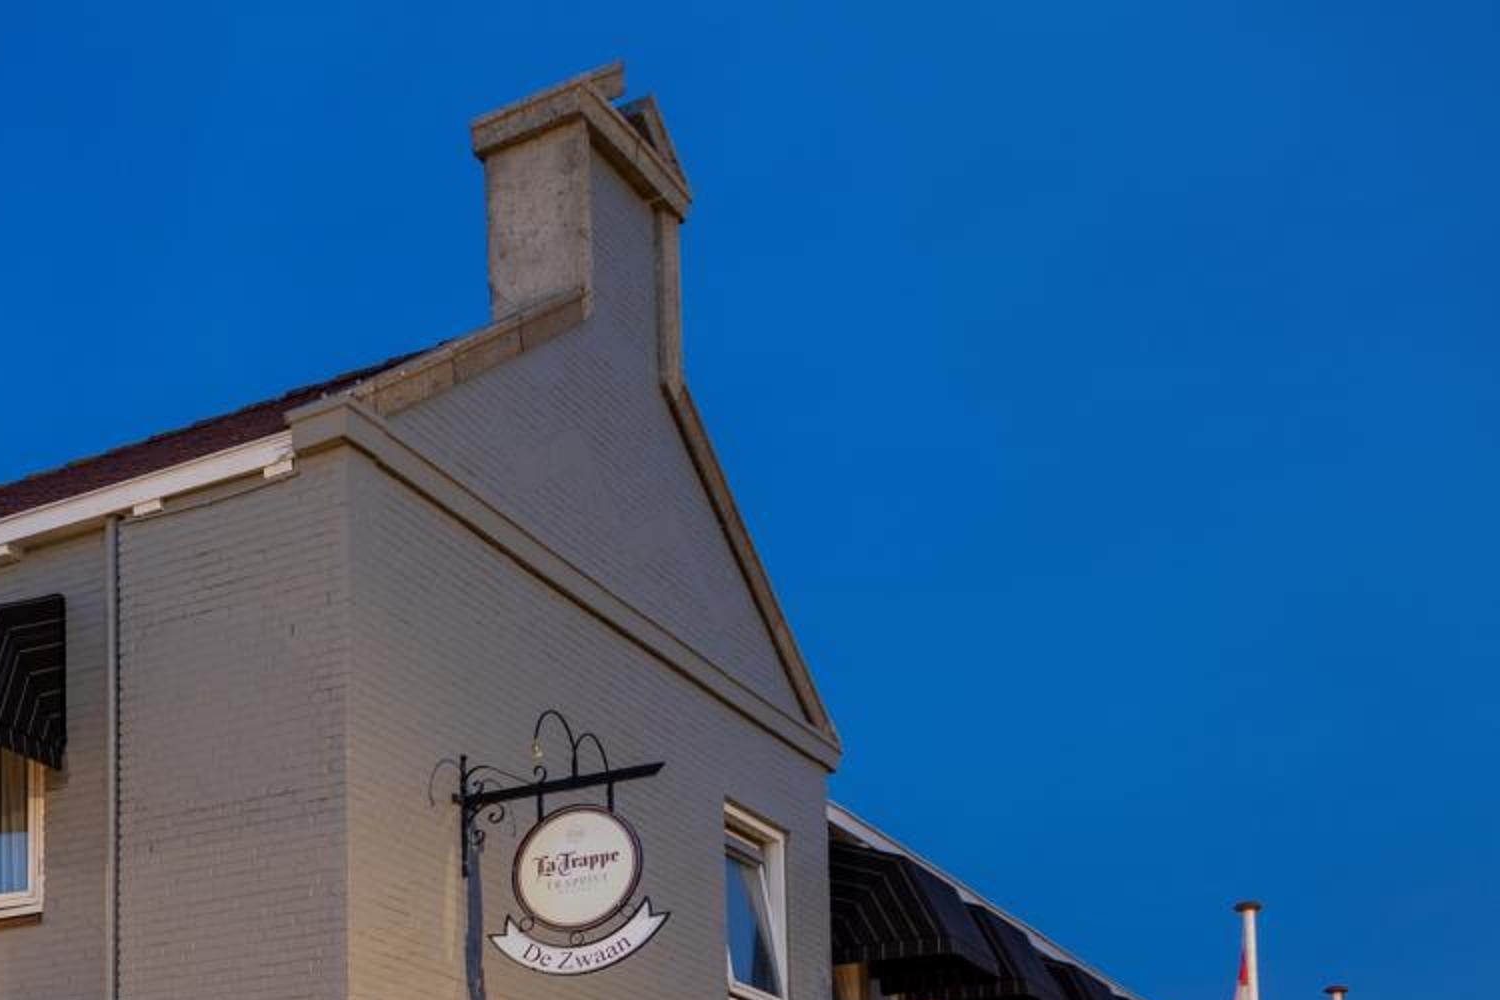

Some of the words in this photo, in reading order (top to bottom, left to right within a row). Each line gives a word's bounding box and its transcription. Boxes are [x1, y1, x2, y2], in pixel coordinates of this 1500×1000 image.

[556, 851, 620, 877] Trappe
[523, 943, 552, 967] De
[558, 937, 632, 969] Zwaan
